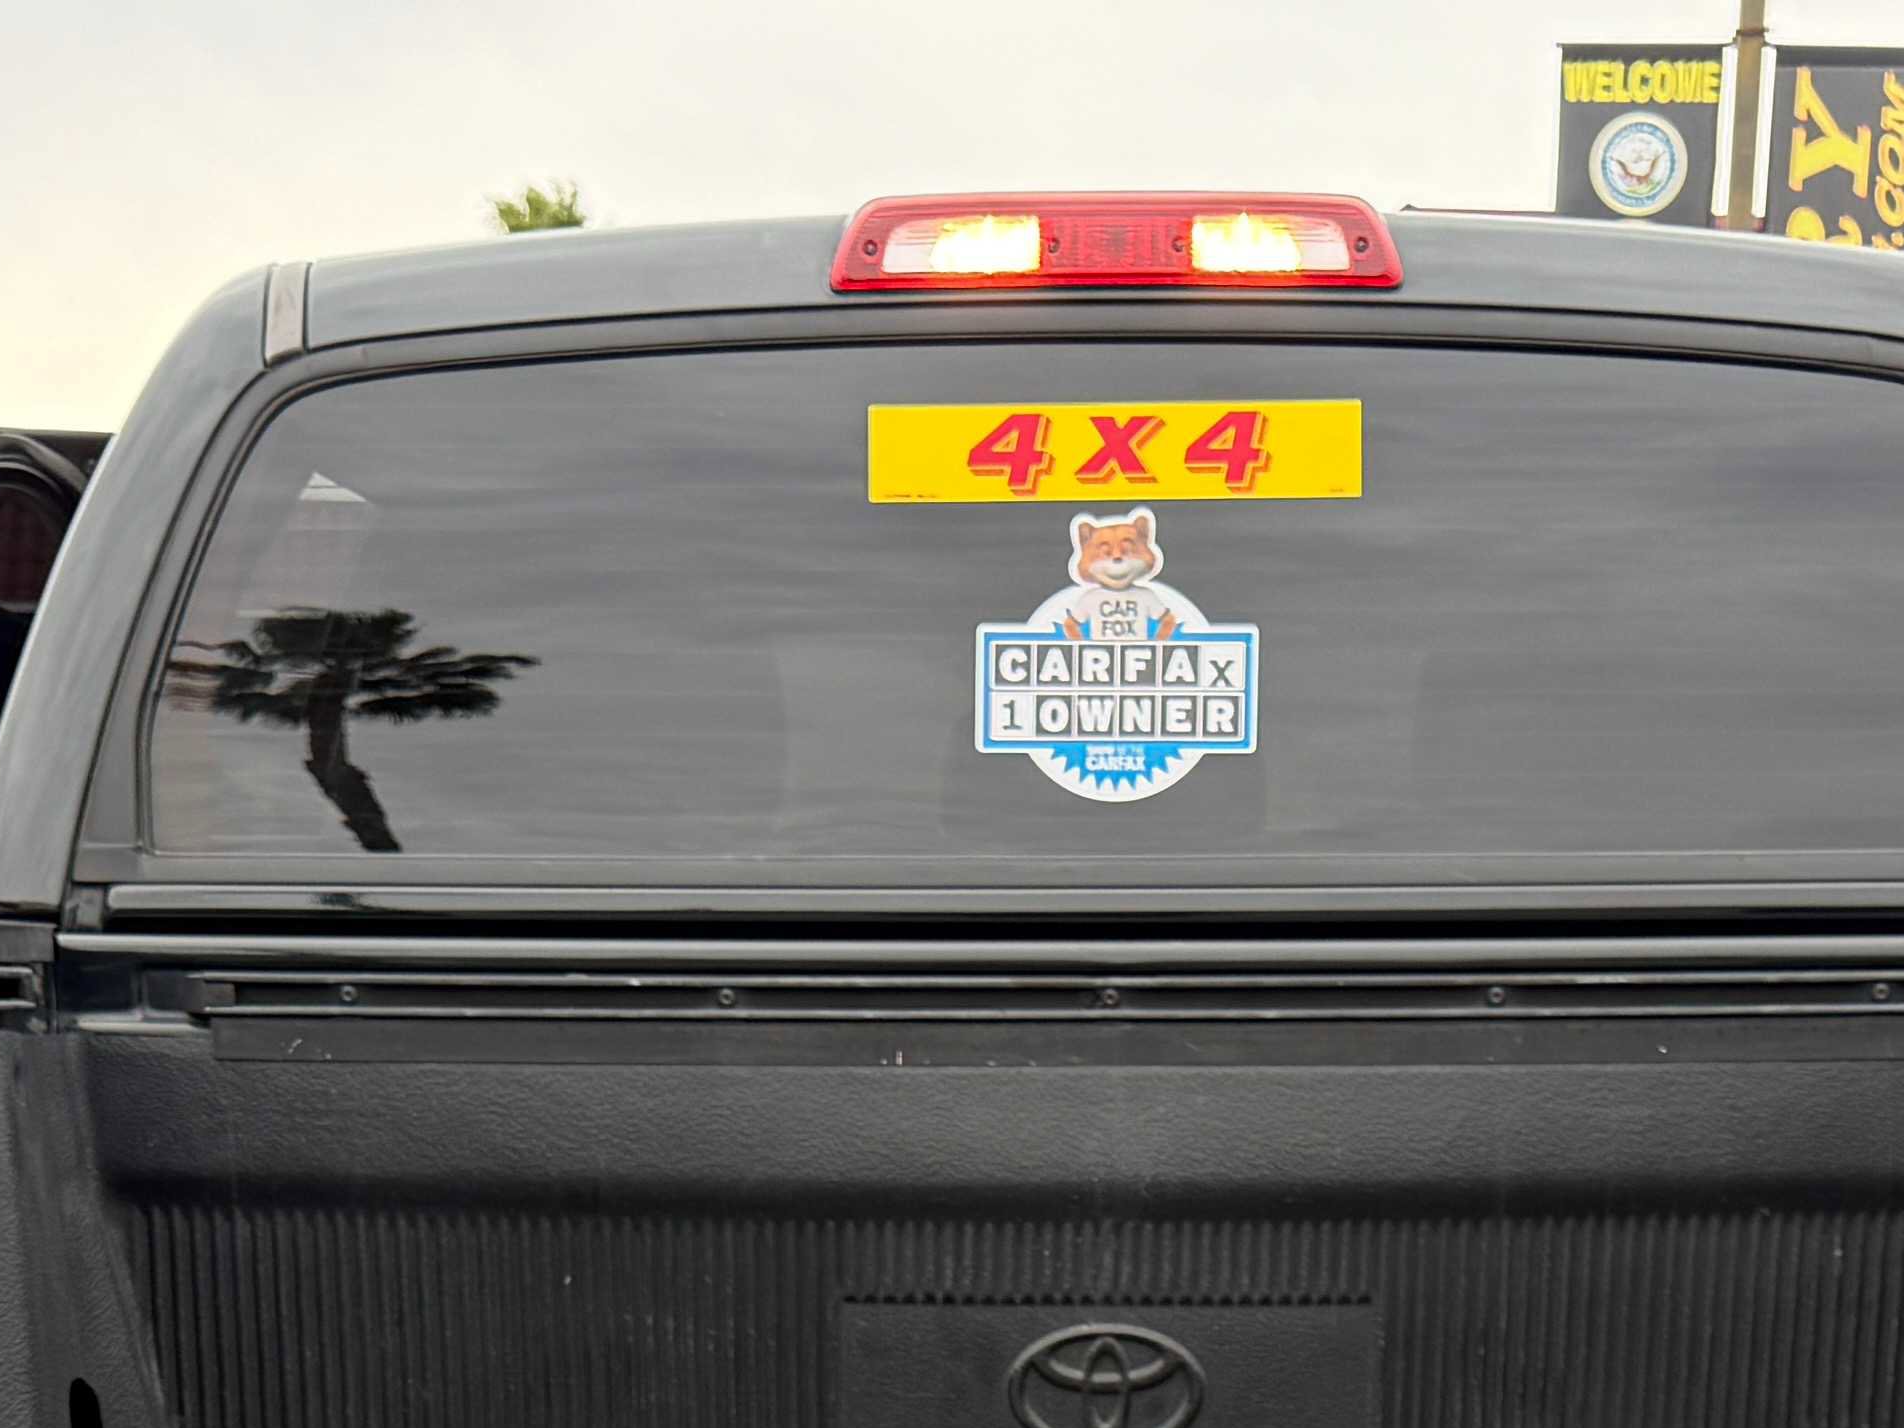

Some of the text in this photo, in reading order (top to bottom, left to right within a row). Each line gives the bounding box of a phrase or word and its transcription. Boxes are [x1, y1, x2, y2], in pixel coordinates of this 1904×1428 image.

[1562, 60, 1723, 104] WELCOME
[1099, 600, 1139, 618] CAR
[1100, 620, 1137, 638] FOX
[998, 648, 1236, 687] CARFAX
